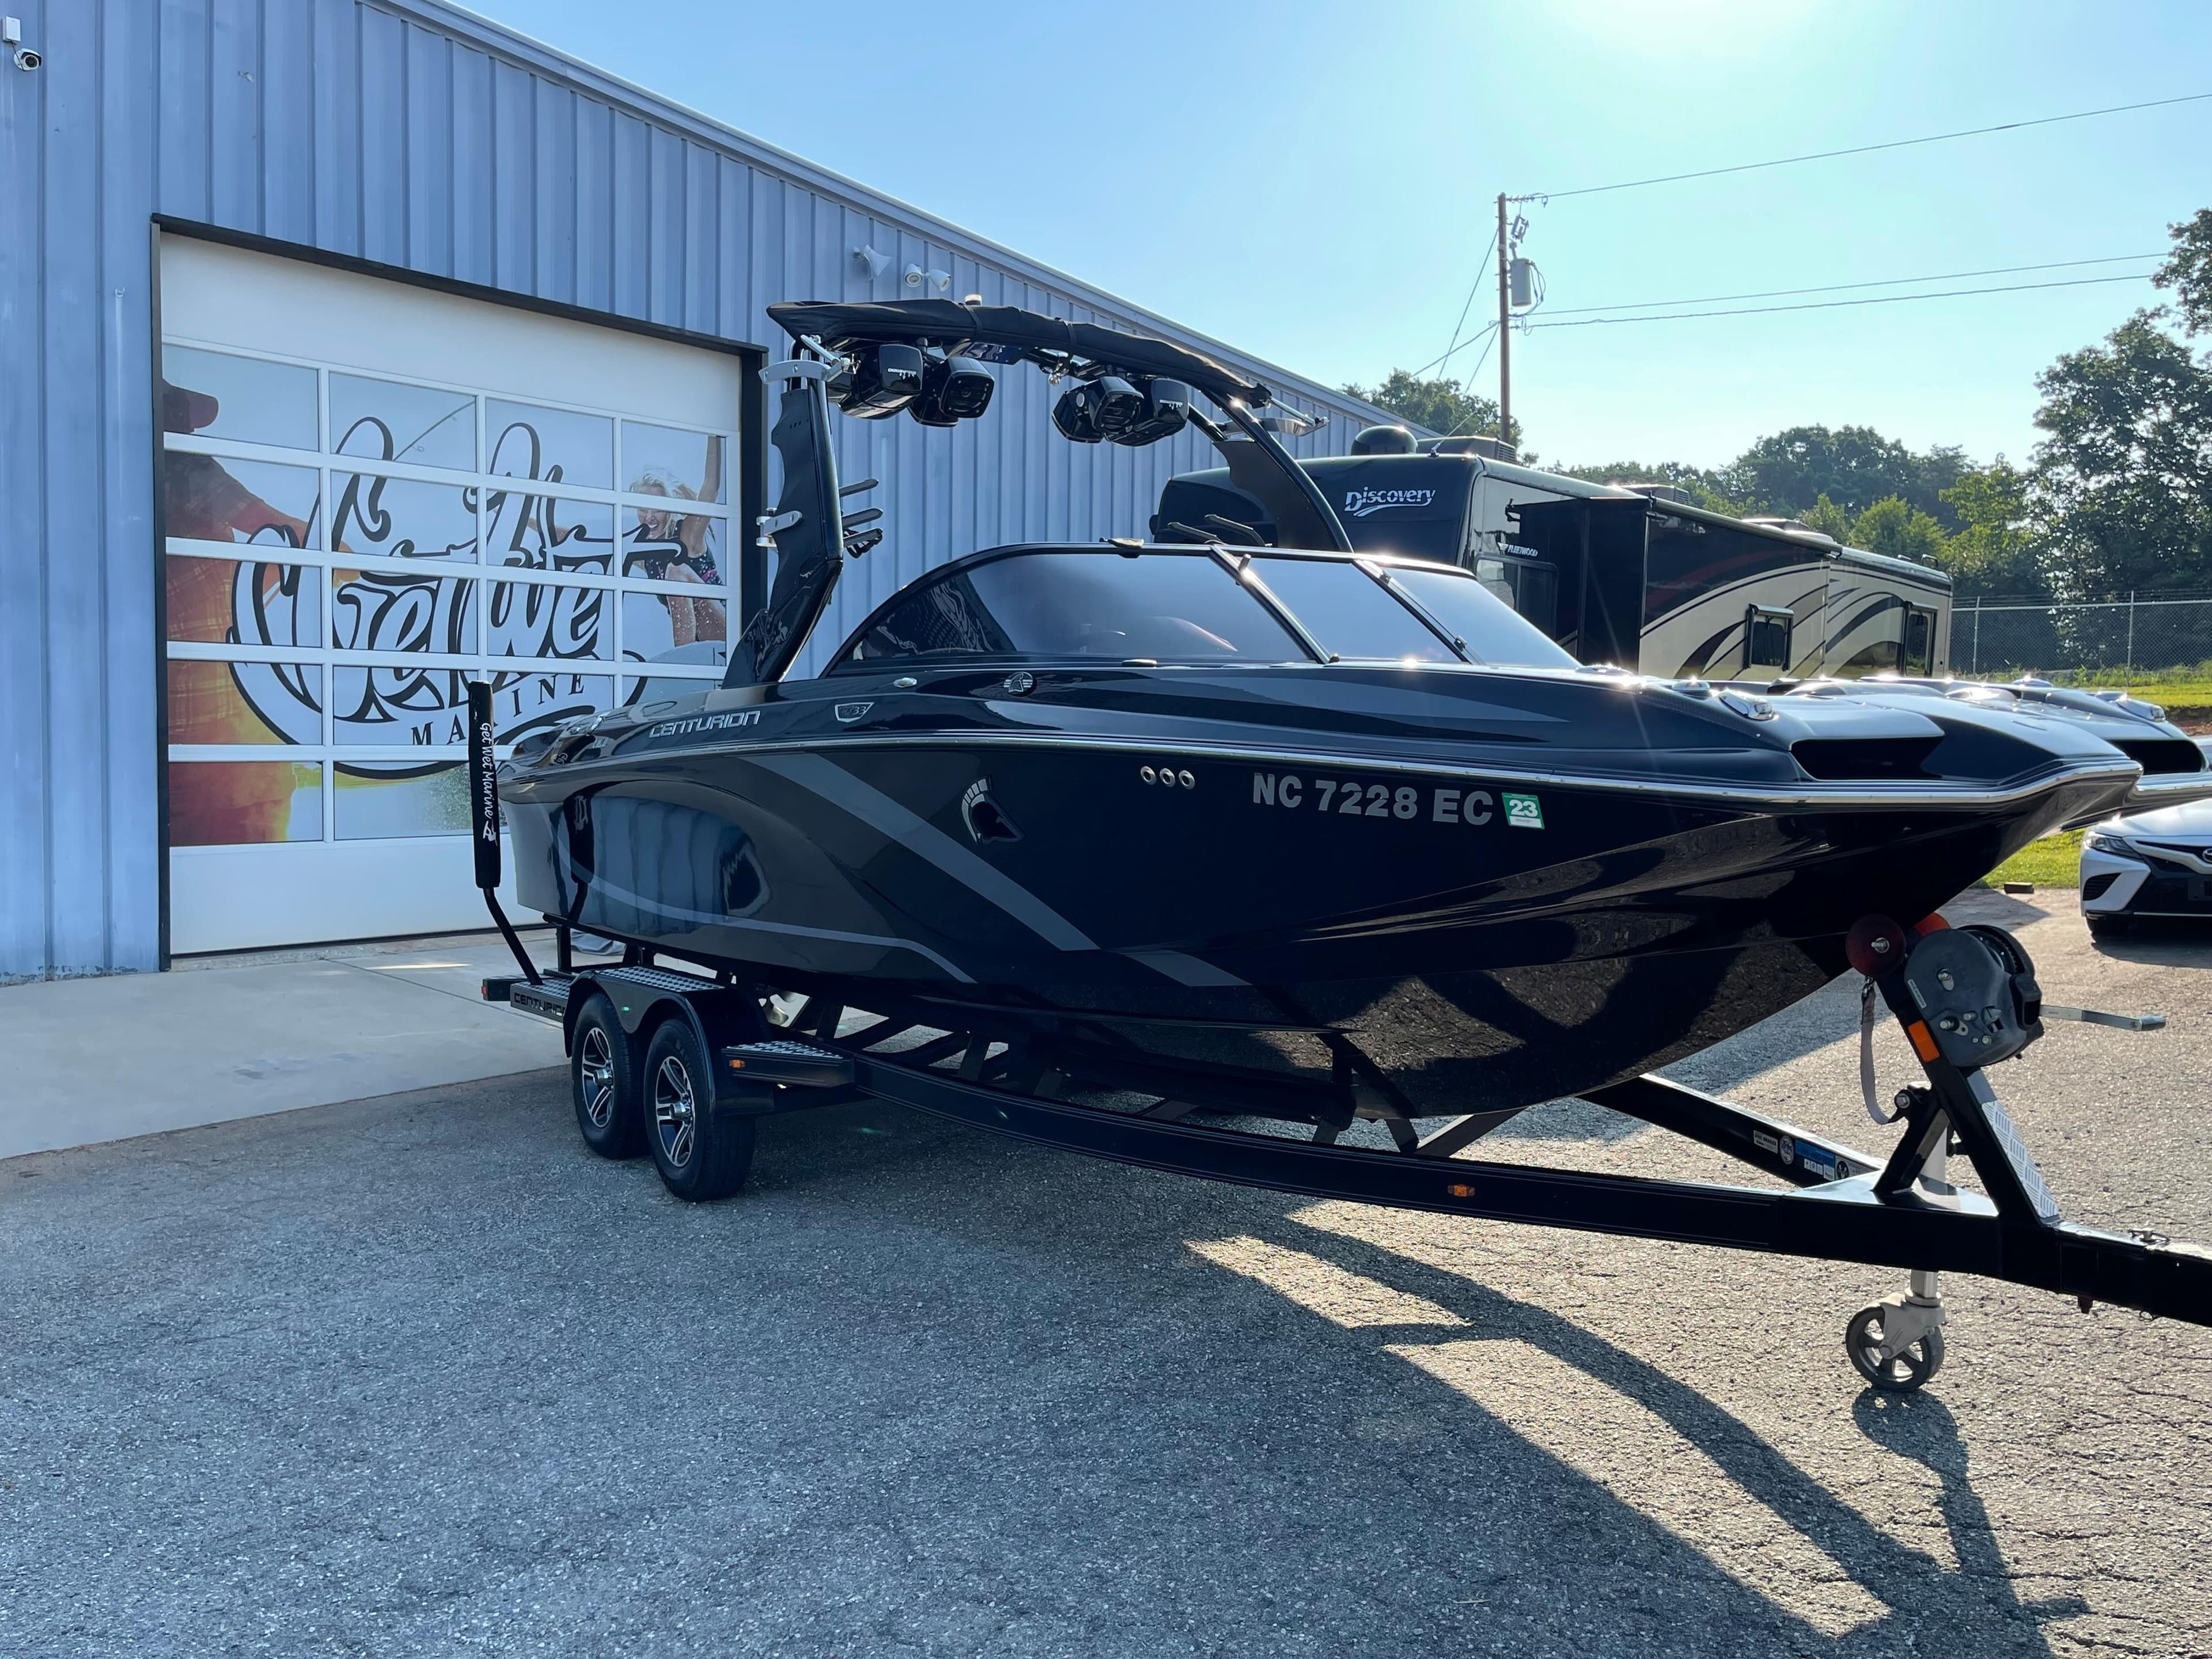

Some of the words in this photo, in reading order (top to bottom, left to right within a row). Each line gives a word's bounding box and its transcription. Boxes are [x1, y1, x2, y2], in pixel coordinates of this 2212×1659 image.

[1344, 486, 1435, 516] Discovery
[411, 673, 584, 745] MAINE
[479, 722, 492, 745] Get
[649, 710, 760, 738] CENTURION
[482, 746, 494, 770] Wet
[482, 771, 494, 819] Marine
[1253, 772, 1302, 808] NC
[1316, 779, 1418, 819] 7228
[1433, 789, 1493, 825] EC
[1509, 799, 1538, 817] 23
